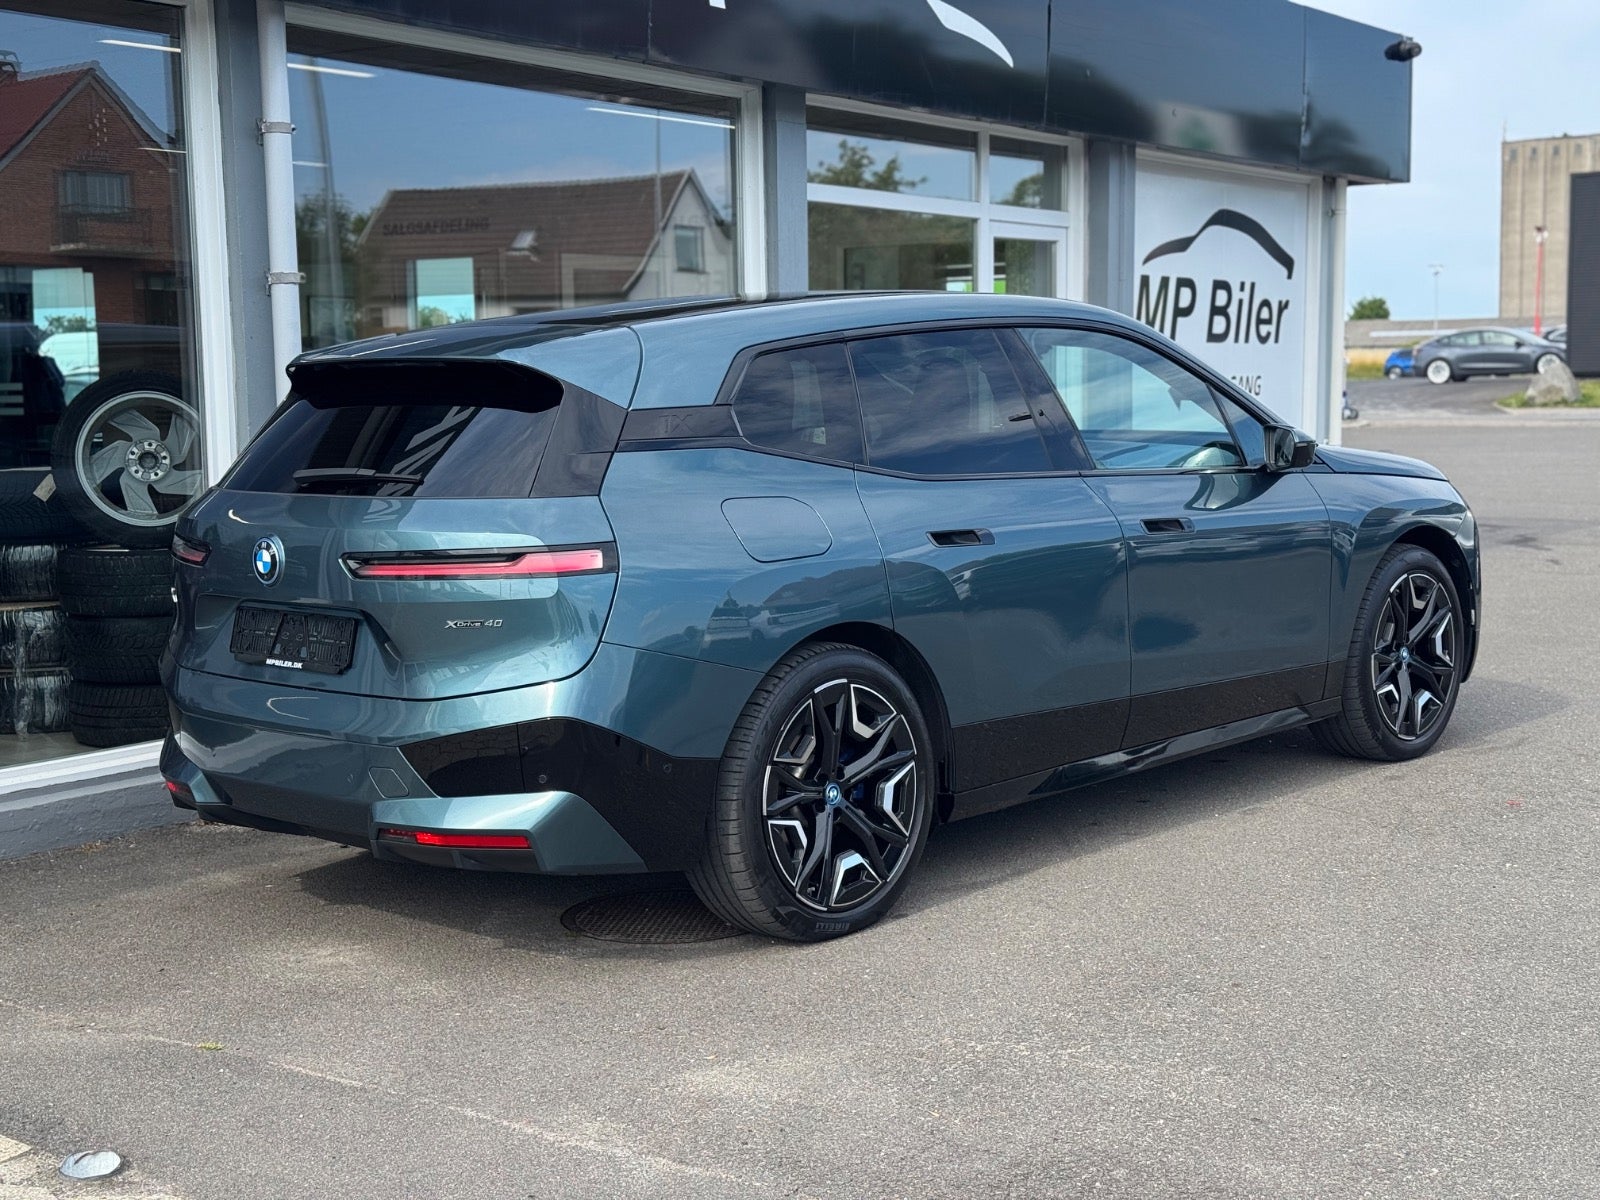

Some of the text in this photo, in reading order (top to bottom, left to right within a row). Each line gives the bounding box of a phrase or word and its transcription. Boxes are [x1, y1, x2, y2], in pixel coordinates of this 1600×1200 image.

[1136, 274, 1290, 345] MP Biler
[1231, 375, 1262, 396] ANG
[484, 619, 503, 628] 40
